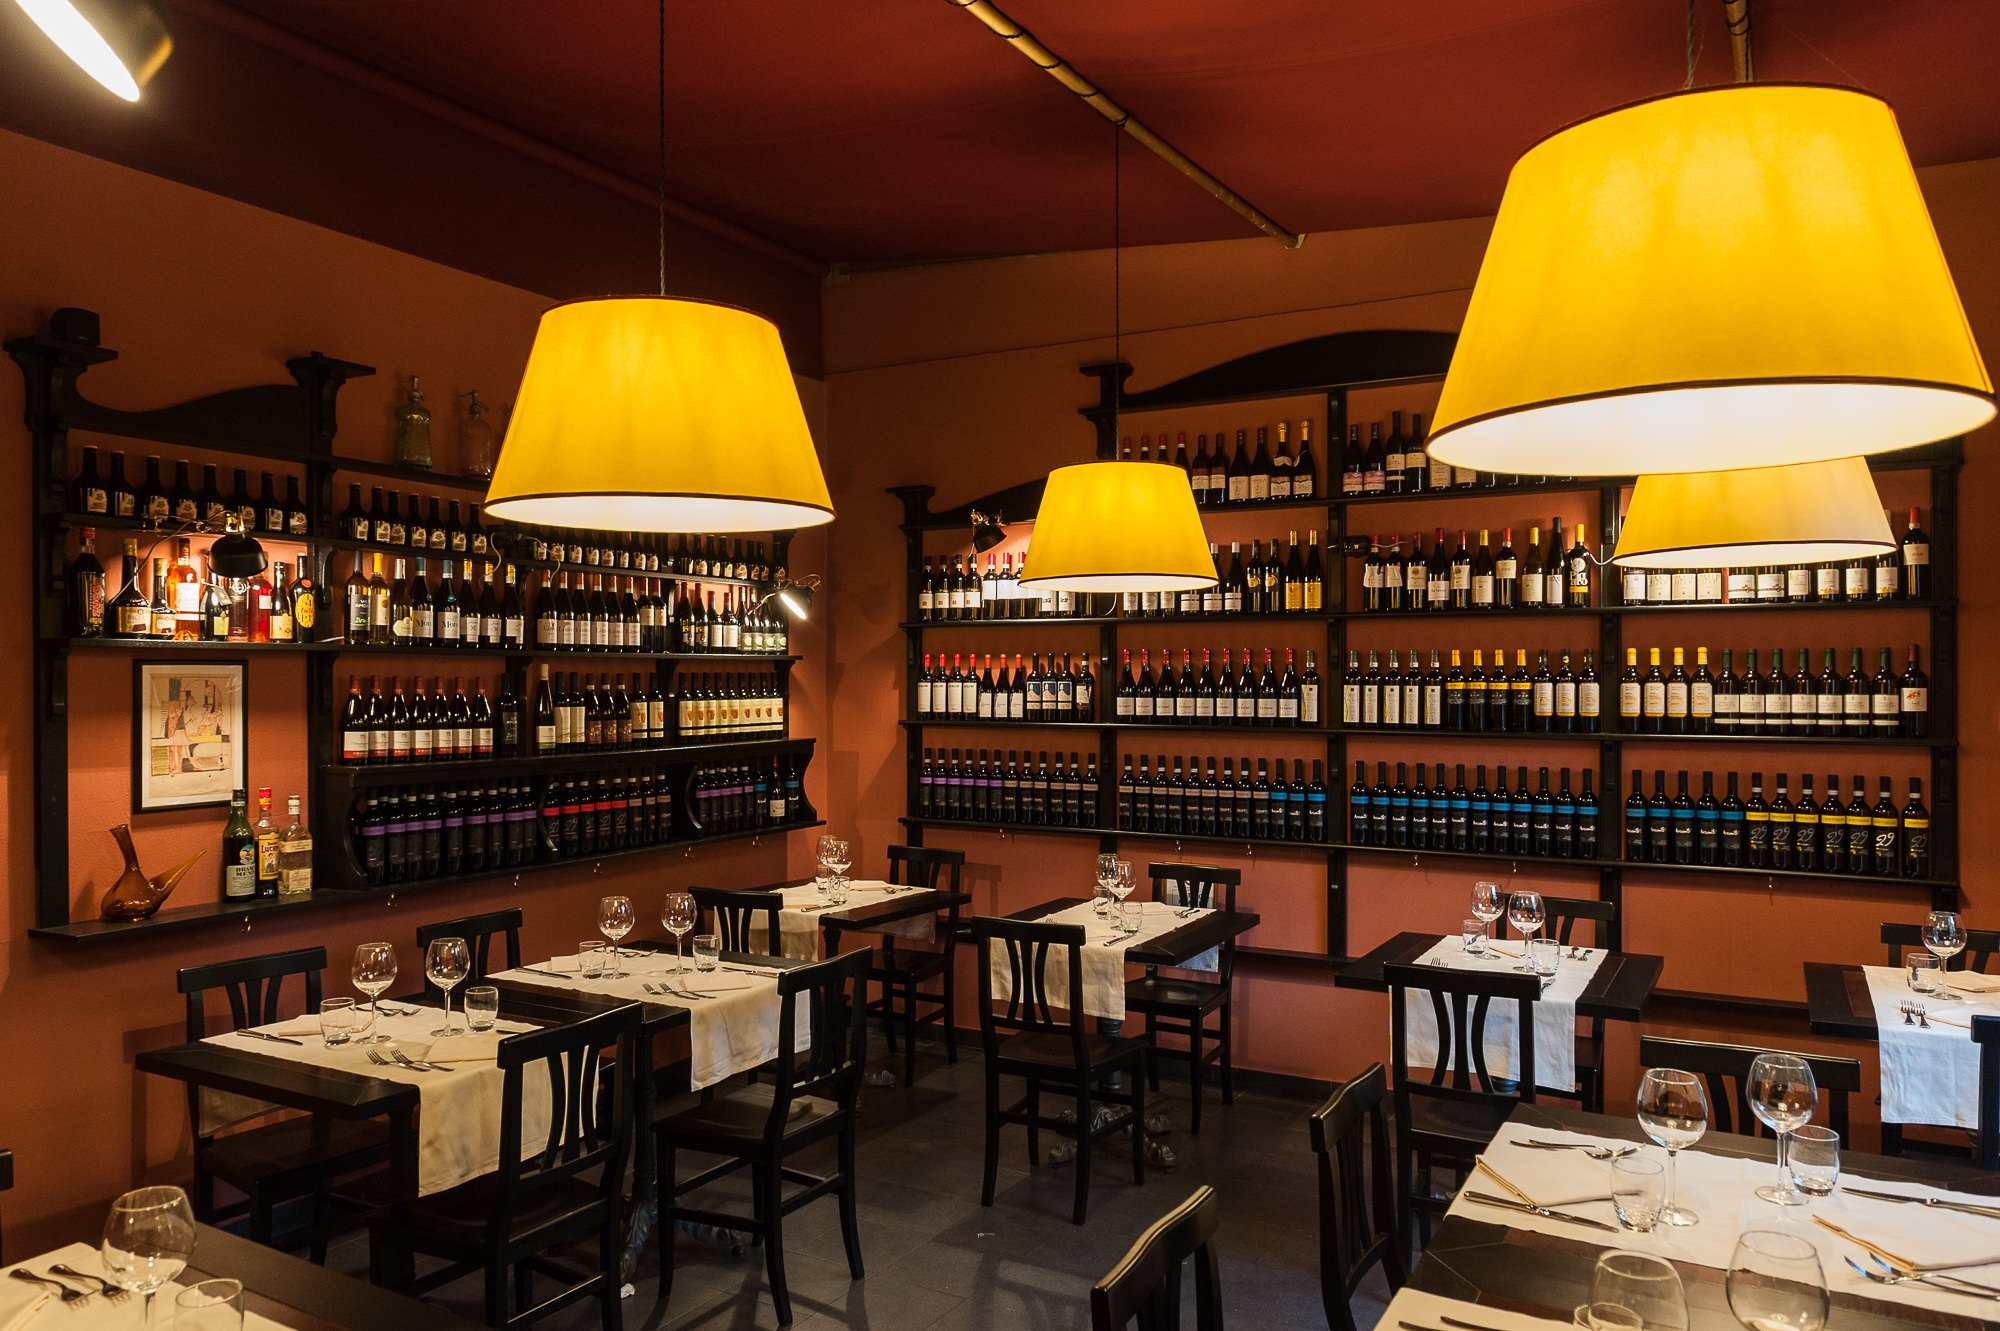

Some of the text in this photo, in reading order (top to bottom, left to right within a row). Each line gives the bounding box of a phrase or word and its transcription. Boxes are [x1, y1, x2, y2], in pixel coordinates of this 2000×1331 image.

[1751, 825, 1768, 840] 29
[1773, 826, 1791, 841] 29
[1796, 827, 1815, 842] 29
[1826, 829, 1844, 844] 29
[1850, 830, 1868, 845] 29
[1875, 832, 1895, 847] 29
[1911, 832, 1928, 848] 29
